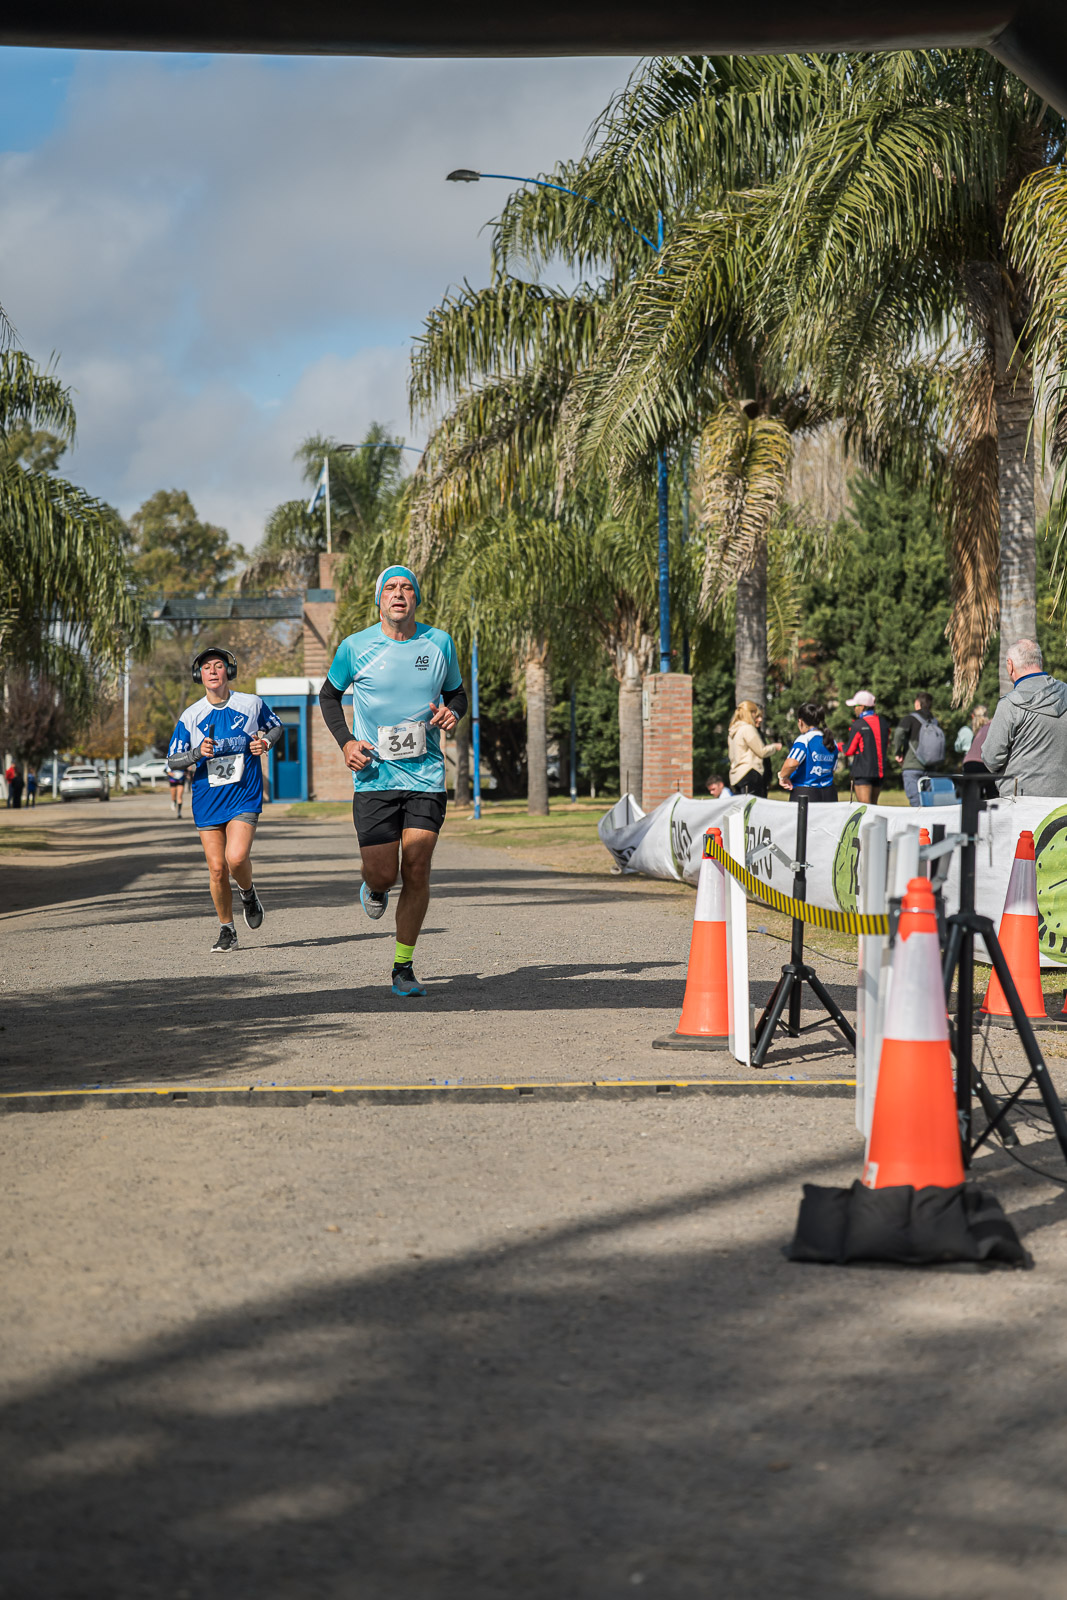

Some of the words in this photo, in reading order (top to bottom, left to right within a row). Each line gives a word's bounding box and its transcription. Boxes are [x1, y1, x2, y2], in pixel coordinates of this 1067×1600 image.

[416, 656, 429, 664] AG
[388, 732, 416, 752] 34
[216, 764, 235, 779] 26
